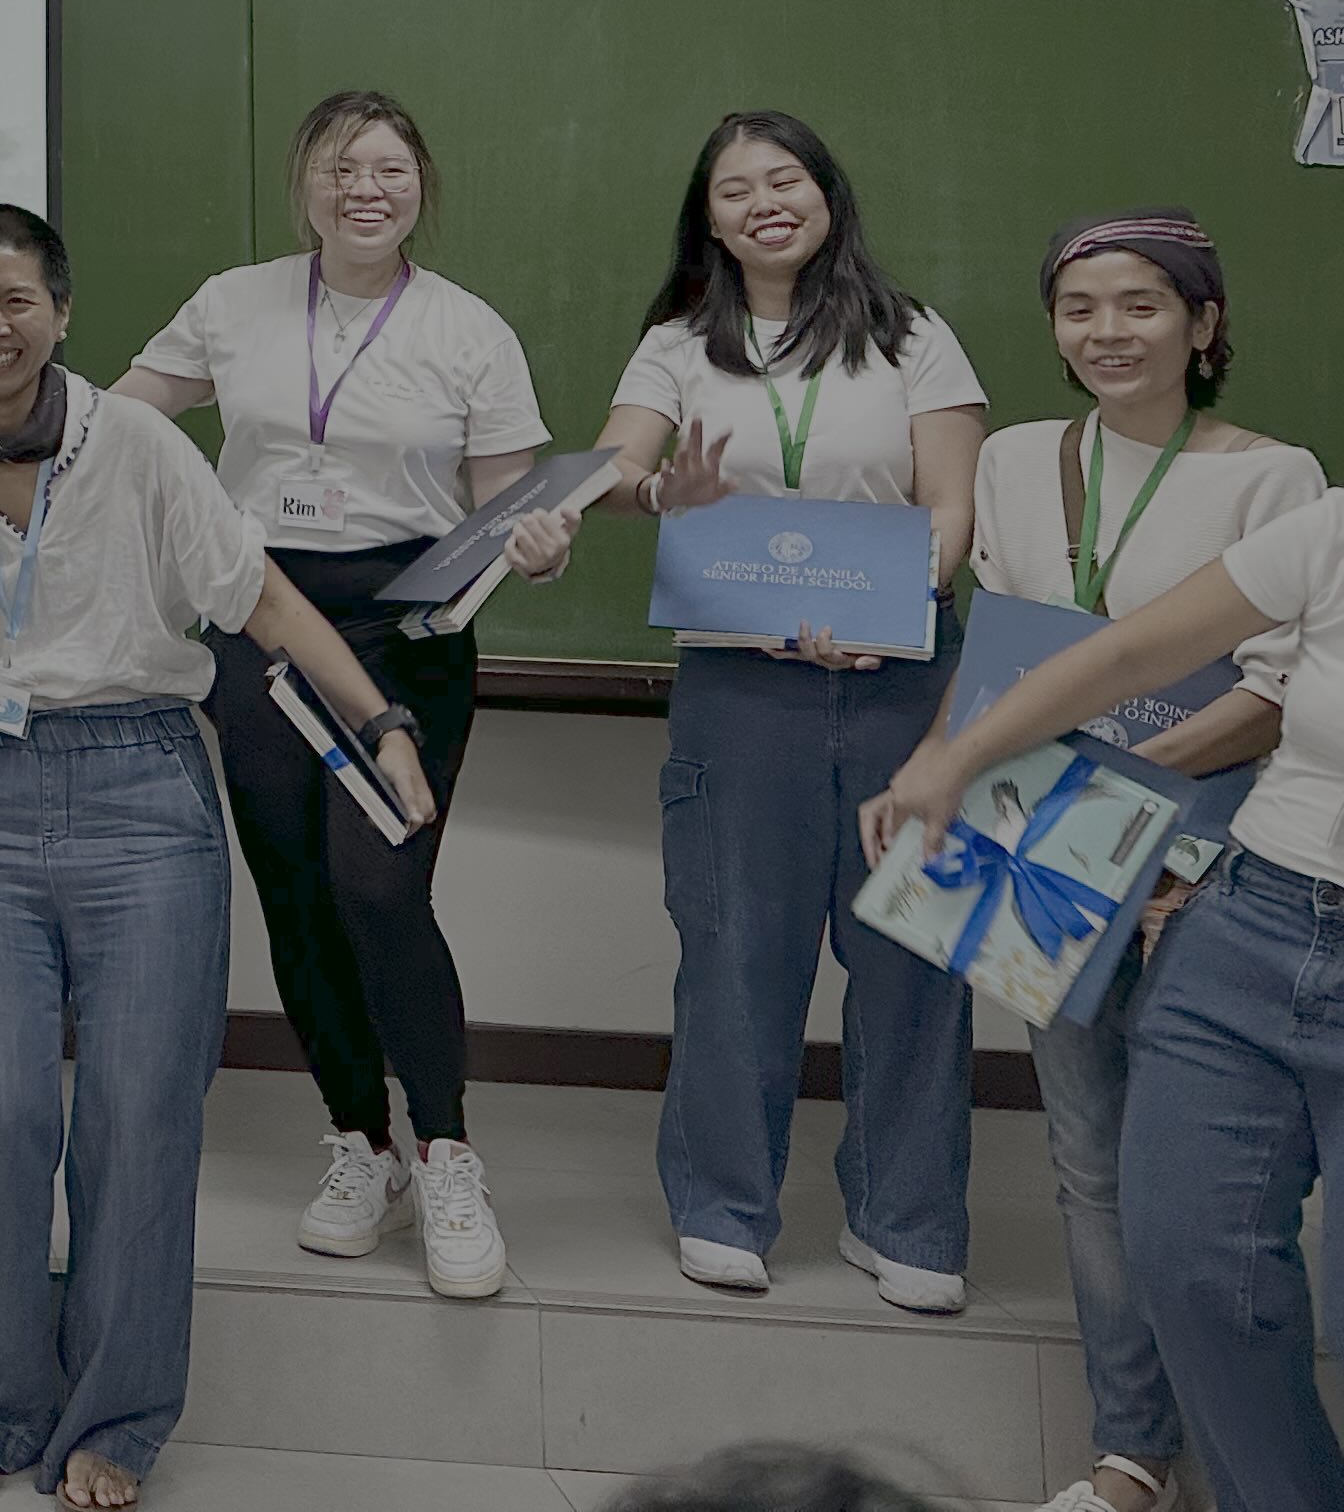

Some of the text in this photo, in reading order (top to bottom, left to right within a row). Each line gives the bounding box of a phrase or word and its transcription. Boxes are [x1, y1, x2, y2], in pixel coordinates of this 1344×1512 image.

[283, 496, 316, 517] Kim
[702, 568, 875, 591] SENIOR HIGH SCHOOL
[712, 560, 866, 581] ATENEO DE MANILA
